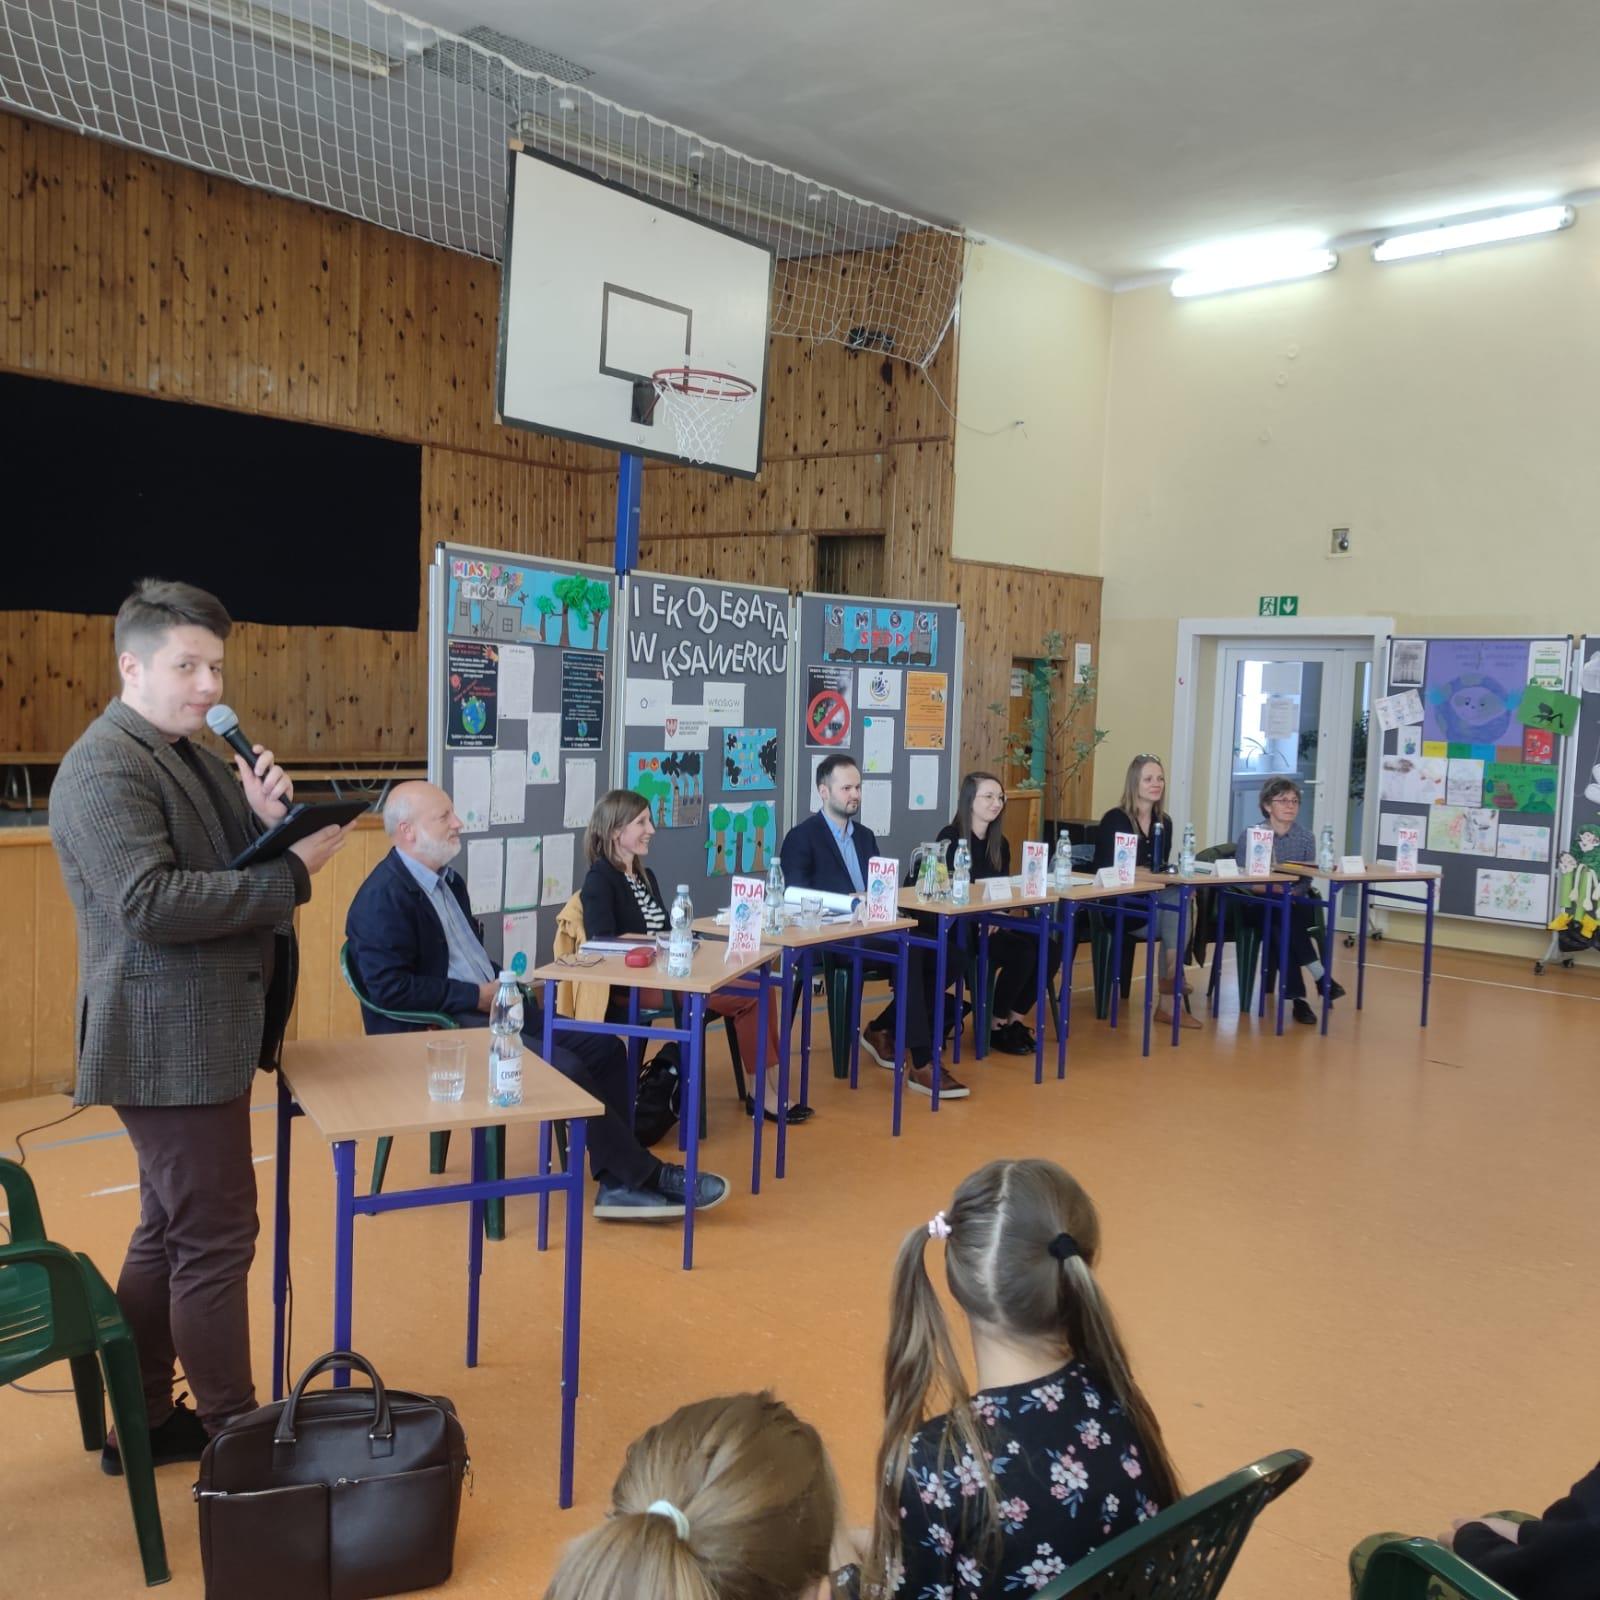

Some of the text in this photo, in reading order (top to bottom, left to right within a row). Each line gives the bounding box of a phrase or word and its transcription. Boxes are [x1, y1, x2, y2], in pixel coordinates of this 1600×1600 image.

[633, 583, 788, 640] I EKODEBATA
[629, 630, 658, 663] W
[661, 639, 788, 680] KSAWERKU
